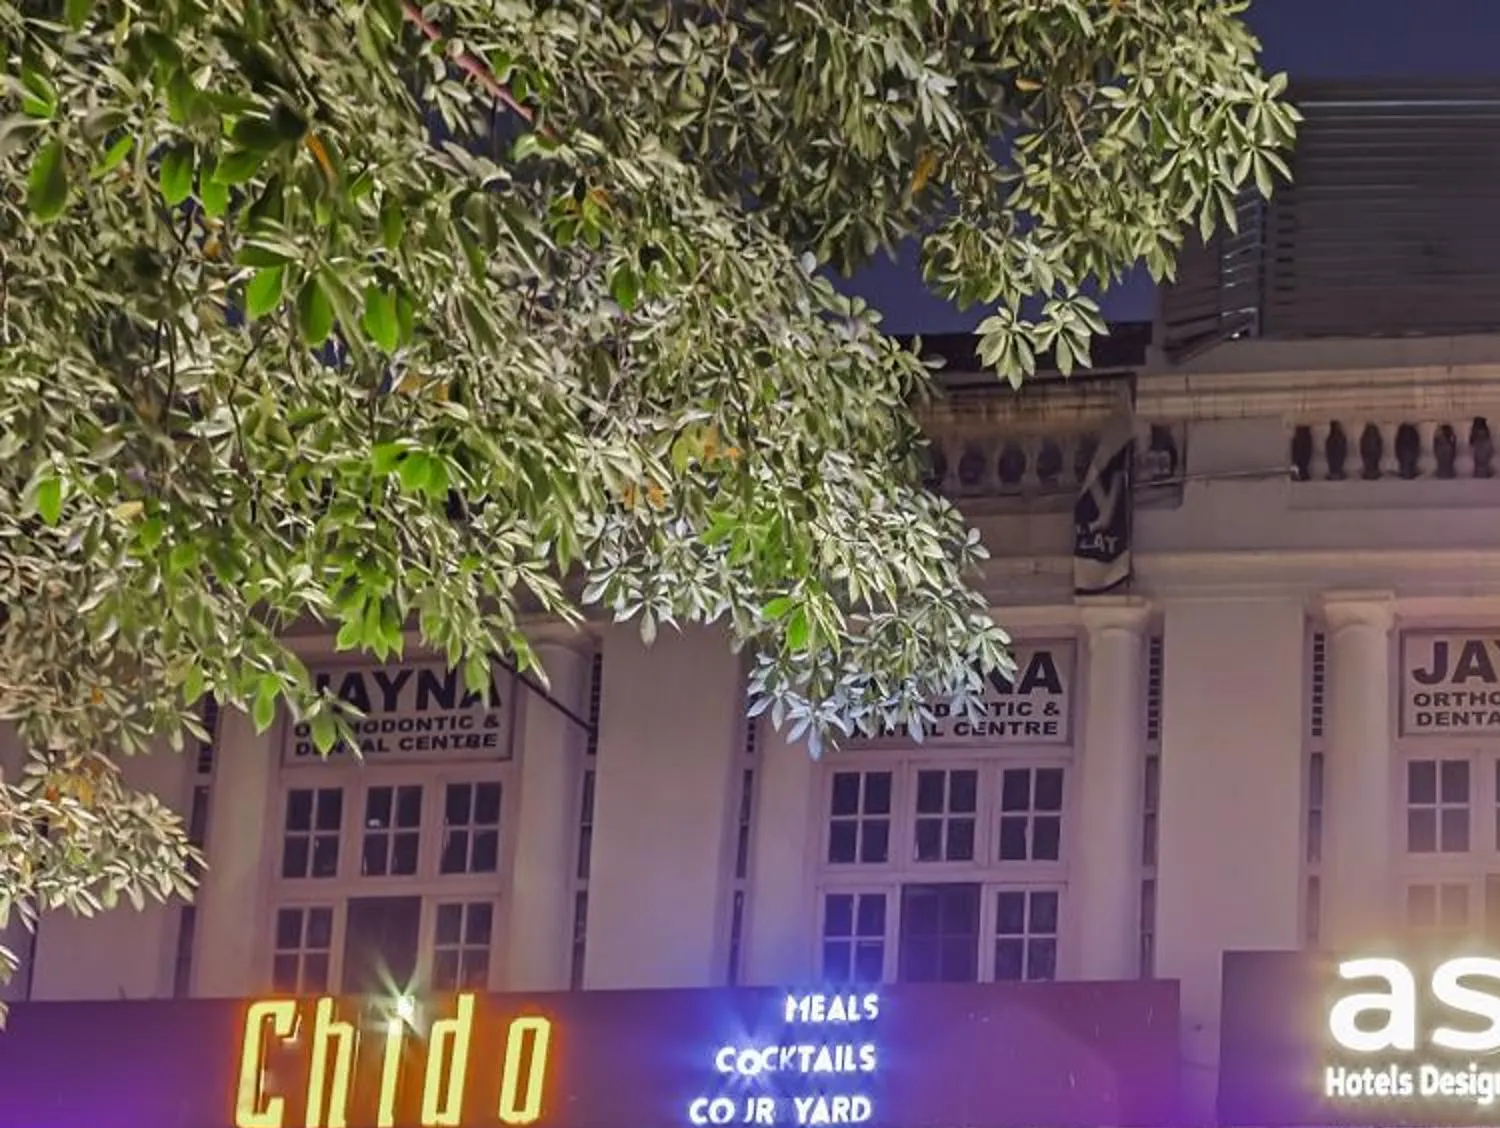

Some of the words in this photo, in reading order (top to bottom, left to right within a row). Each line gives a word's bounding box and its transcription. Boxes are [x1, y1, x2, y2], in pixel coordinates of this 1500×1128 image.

[1043, 701, 1060, 717] &
[483, 713, 500, 729] &
[953, 721, 1058, 737] CENTRE
[398, 733, 497, 751] CENTRE
[784, 993, 880, 1023] MEALS
[715, 1043, 877, 1075] COCKTAILS
[1326, 1065, 1413, 1096] Hotels
